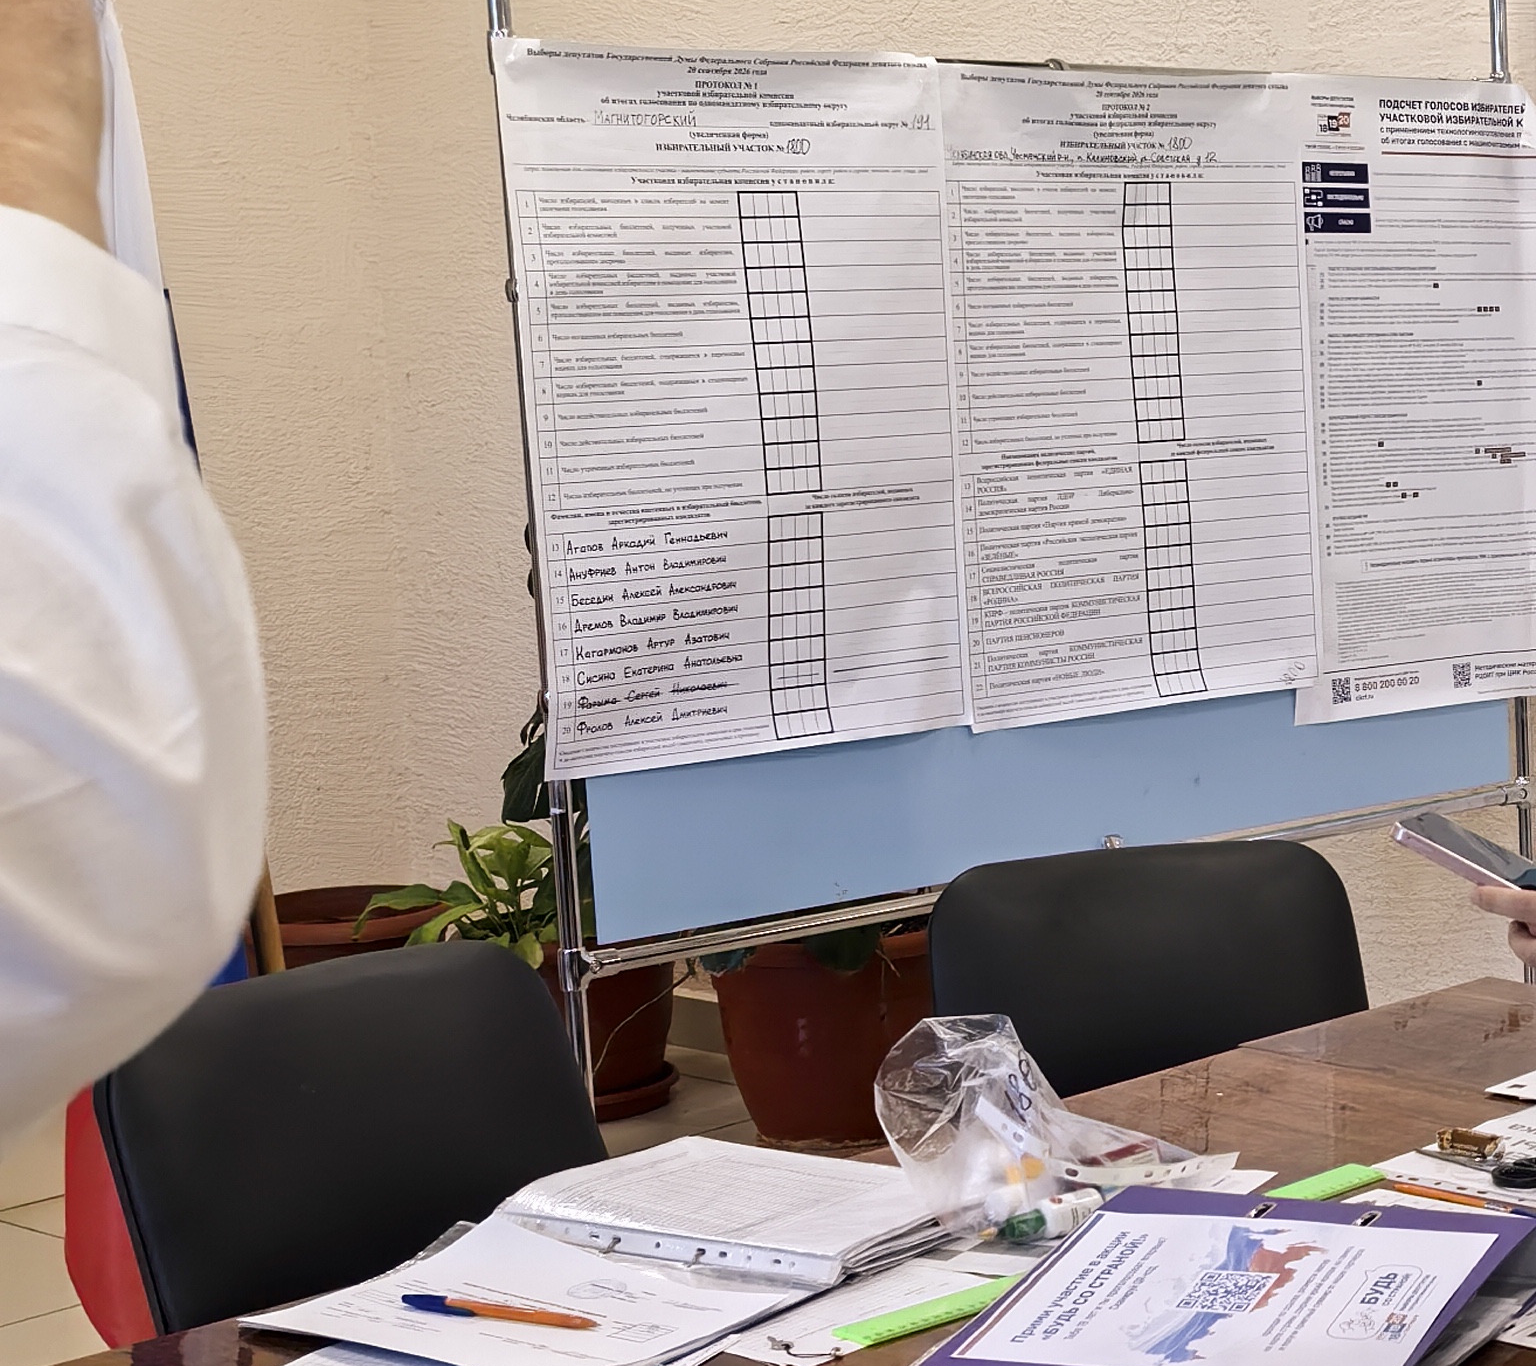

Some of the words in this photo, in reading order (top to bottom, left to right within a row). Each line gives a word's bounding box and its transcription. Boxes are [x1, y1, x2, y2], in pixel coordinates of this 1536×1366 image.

[527, 48, 561, 58] Выборы
[606, 52, 672, 63] Государственной
[699, 56, 752, 67] Федерального
[695, 81, 742, 89] ПРОТОКОЛ
[1379, 99, 1422, 111] ПОДСЧЕТ
[1424, 101, 1469, 112] ГОЛОСОВ
[1471, 102, 1526, 115] ИЗБИРАТЕЛЕЙ
[911, 114, 930, 130] 191
[1338, 115, 1350, 125] 20
[1379, 113, 1444, 125] УЧАСТКОВОЙ
[1446, 115, 1514, 127] ИЗБИРАТЕЛЬНОЙ
[655, 142, 730, 152] ИЗБИРАТЕЛЬНЫЙ
[732, 143, 776, 153] УЧАСТОК
[1168, 137, 1192, 151] 1800
[1205, 151, 1218, 163] 12
[612, 535, 656, 551] Аркадий
[569, 566, 616, 582] Ануфриев
[625, 561, 656, 575] Антон
[663, 555, 726, 571] Владимирович
[572, 592, 614, 607] Беседин
[622, 585, 662, 601] Алексей
[669, 581, 737, 597] Александрович
[574, 619, 614, 633] Дремов
[620, 613, 666, 627] Владимир
[673, 605, 738, 621] Владимирович
[647, 633, 675, 649] Артур
[684, 631, 730, 645] Азатович
[624, 663, 674, 679] Екатерина
[684, 653, 742, 669] Анатольевна
[1380, 679, 1396, 689] 200
[1409, 676, 1420, 685] 20
[576, 721, 614, 735] Фролов
[624, 712, 663, 727] Алексей
[672, 706, 728, 721] Дмитриевич
[1010, 1310, 1052, 1343] Прими
[1048, 1268, 1094, 1307] участие
[1099, 1231, 1131, 1260] акции
[1359, 1272, 1398, 1306] БУДЬ
[1042, 1307, 1079, 1341] «БУДЬ
[1077, 1289, 1097, 1305] СО
